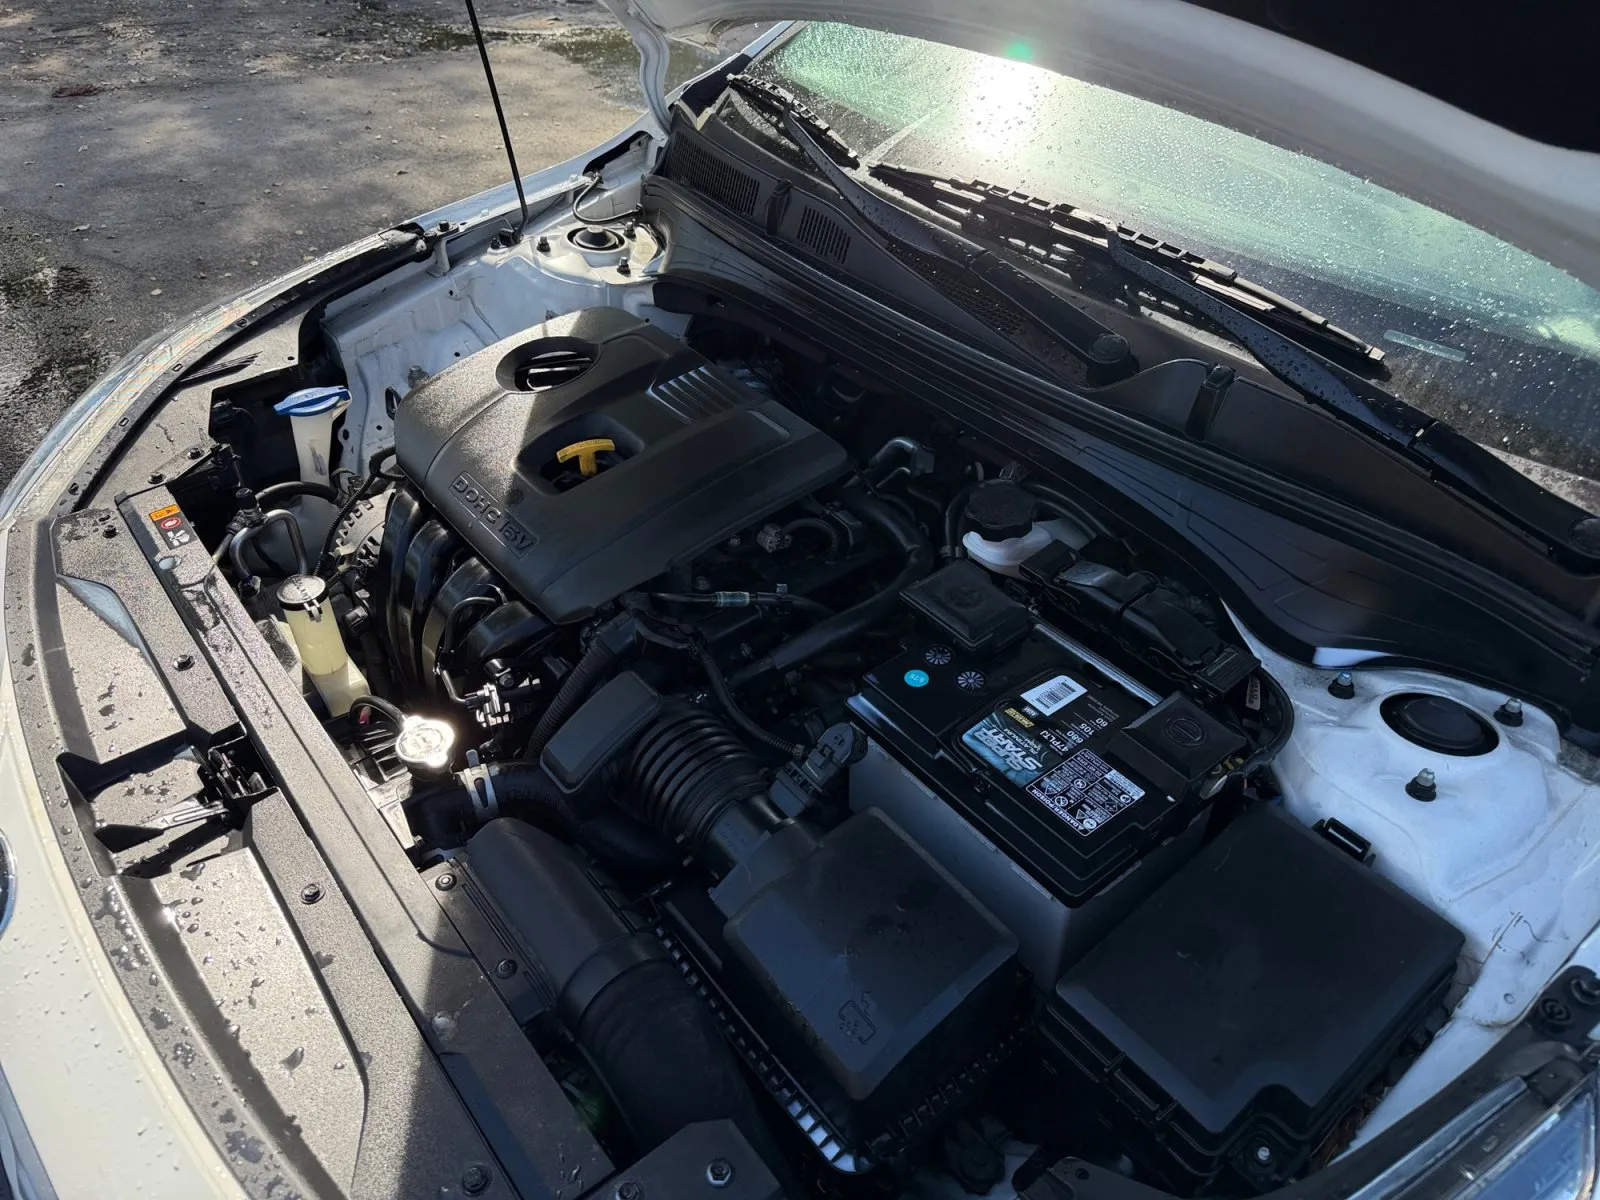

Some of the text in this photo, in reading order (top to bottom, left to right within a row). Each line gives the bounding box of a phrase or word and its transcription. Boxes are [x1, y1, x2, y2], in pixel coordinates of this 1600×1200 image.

[453, 476, 535, 550] DOHC 16V
[1079, 723, 1095, 736] 105
[1095, 718, 1109, 728] 60
[981, 728, 1043, 770] START
[1003, 728, 1038, 755] PLATINUM
[1040, 730, 1069, 752] 47PLTJ
[1066, 730, 1084, 744] 680
[974, 729, 1022, 770] SUPER
